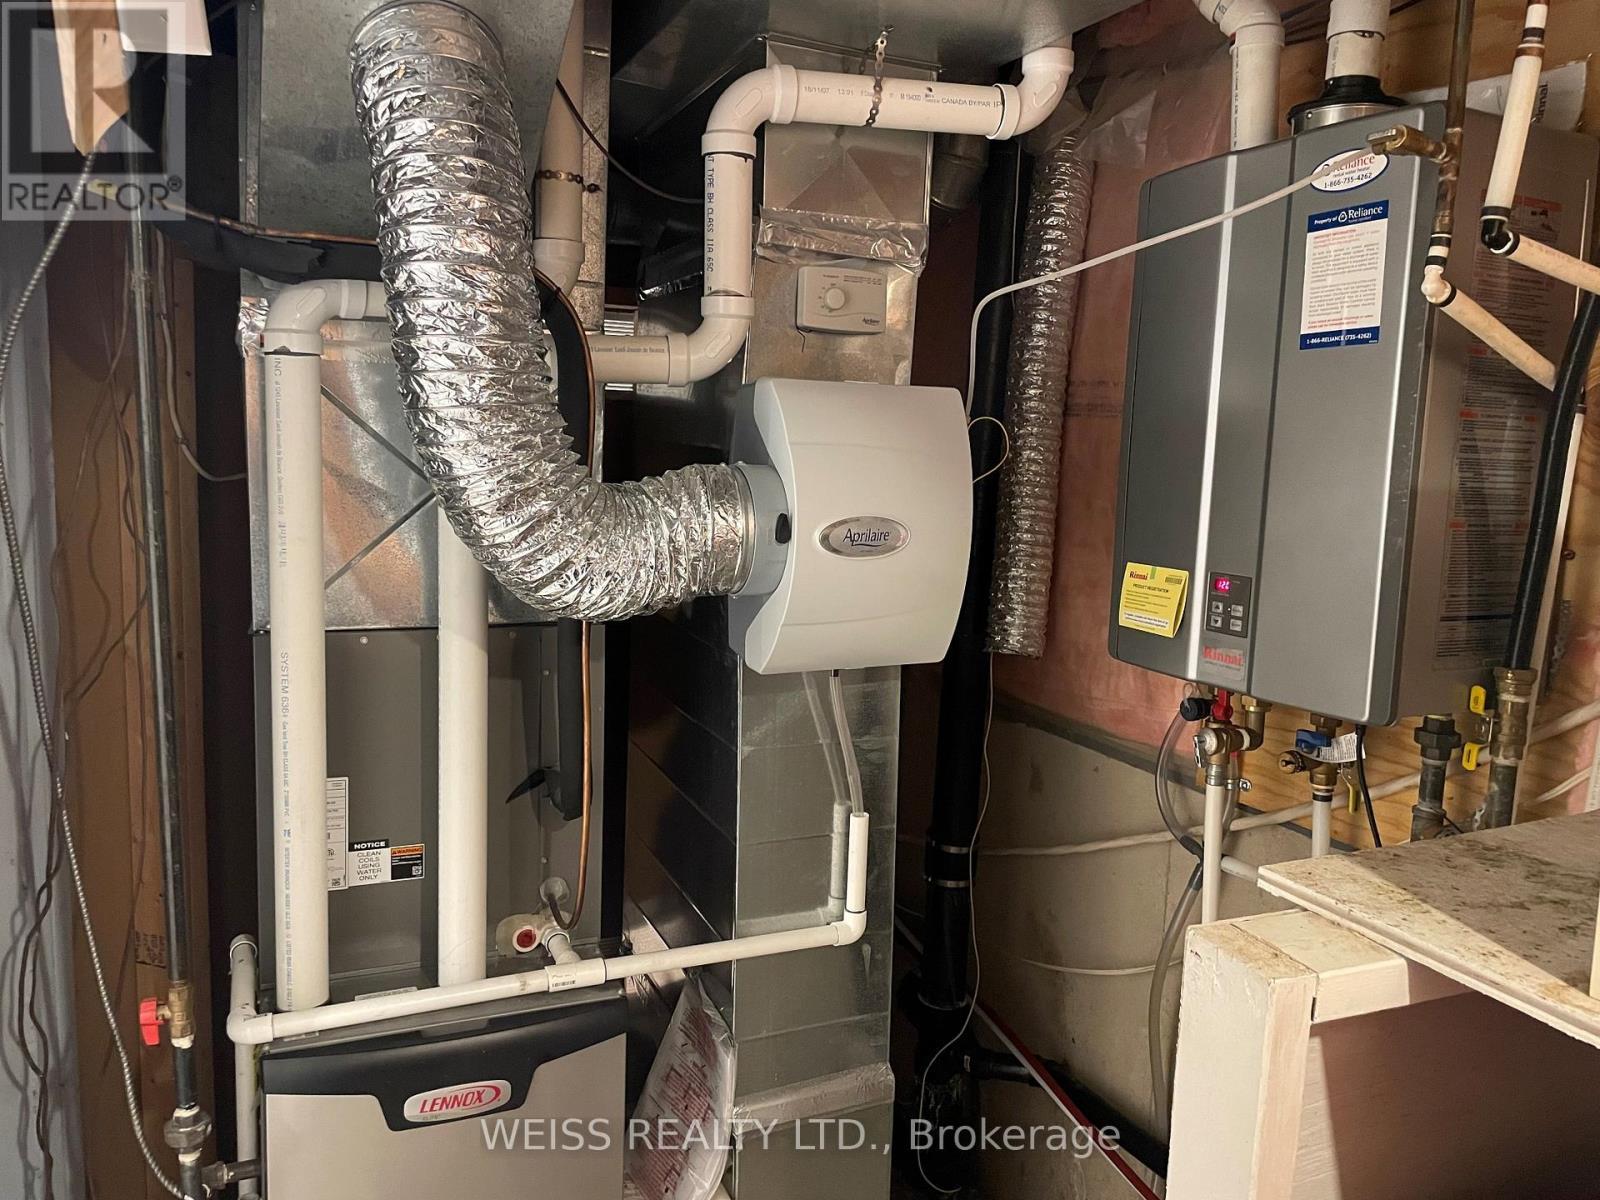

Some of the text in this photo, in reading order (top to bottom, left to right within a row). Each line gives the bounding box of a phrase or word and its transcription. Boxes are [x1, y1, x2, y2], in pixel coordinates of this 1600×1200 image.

[1333, 155, 1375, 171] eiance
[706, 168, 715, 188] TYPE
[1348, 206, 1383, 219] Reliance
[706, 208, 715, 233] CLASS
[843, 528, 889, 546] Aprilaire
[1129, 570, 1149, 581] Rinnai
[280, 652, 289, 694] SYSTEM
[354, 841, 386, 850] NOTICE
[356, 850, 381, 858] CLEAN
[358, 856, 380, 864] COILS
[358, 862, 380, 870] USING
[420, 1089, 486, 1113] LENNOX
